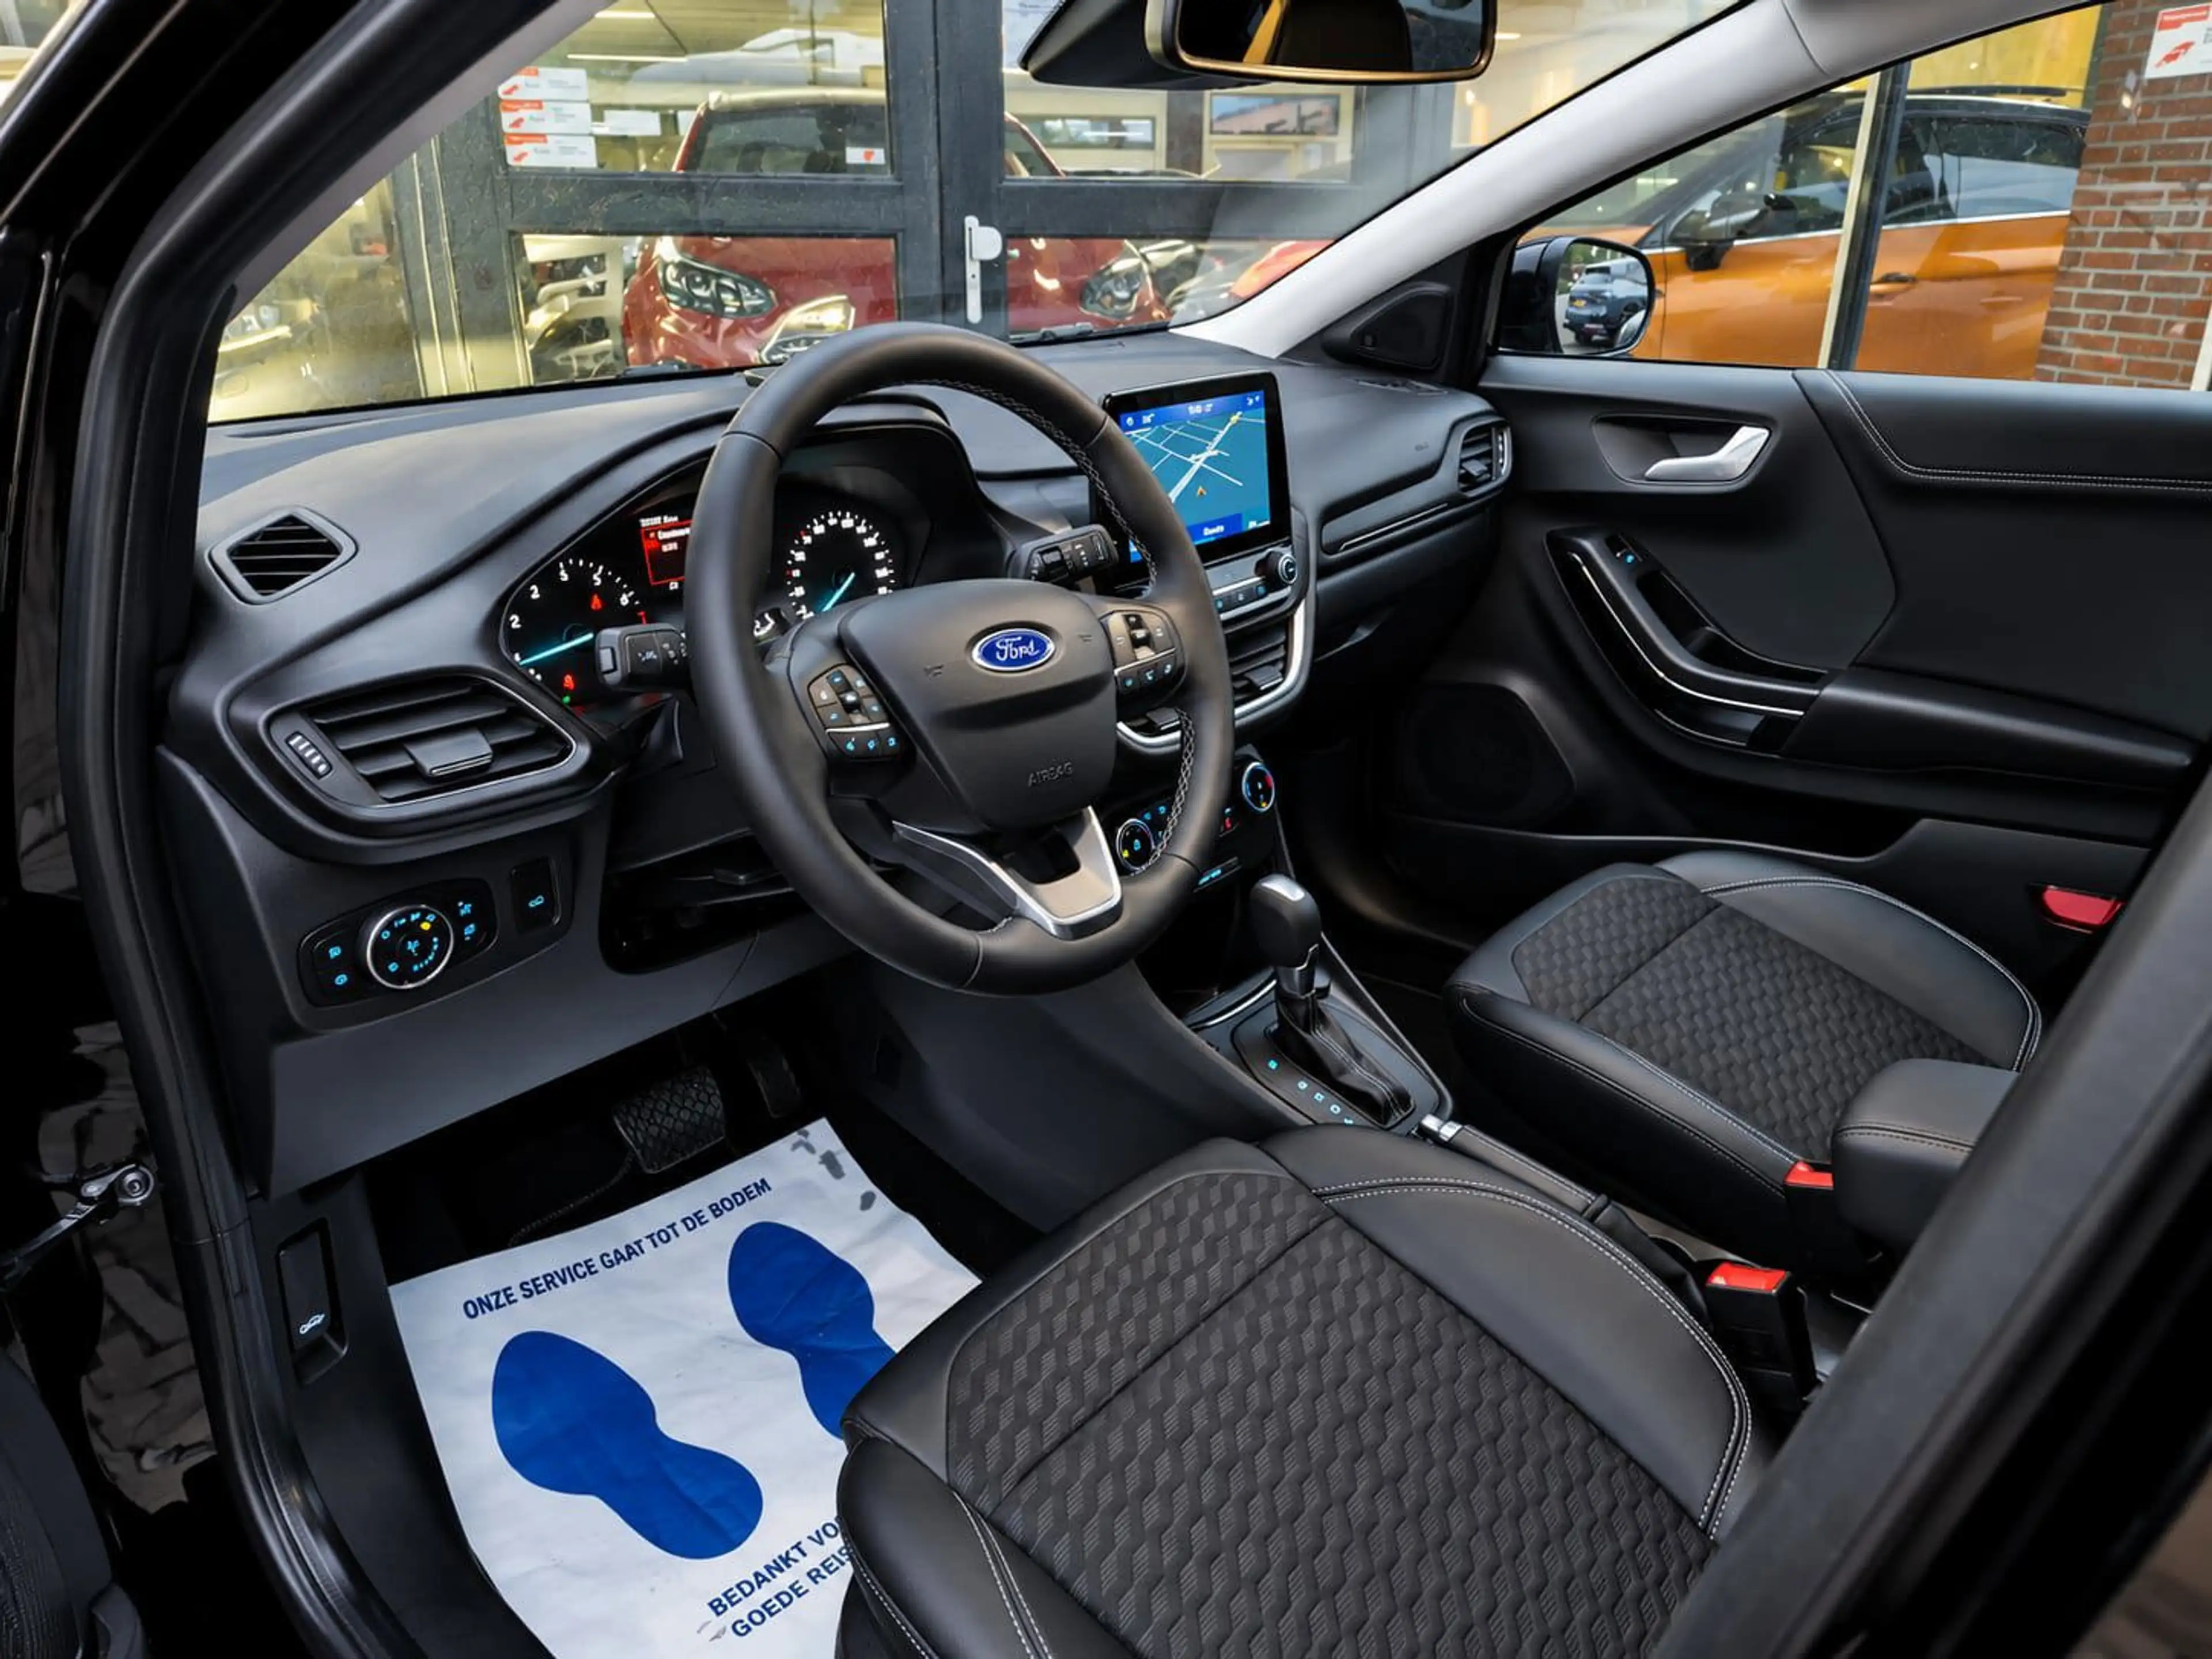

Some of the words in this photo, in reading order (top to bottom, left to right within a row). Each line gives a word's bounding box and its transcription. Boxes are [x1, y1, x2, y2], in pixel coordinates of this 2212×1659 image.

[995, 636, 1040, 661] Ford
[1027, 762, 1074, 787] AIRBAG
[463, 1286, 518, 1320] ONZE
[519, 1257, 599, 1300] SERVICE
[599, 1238, 646, 1270] GAAT
[646, 1221, 682, 1249] TOT
[681, 1209, 709, 1232] DE
[708, 1177, 772, 1218] BODEM
[707, 1541, 808, 1618] BEDANKT
[807, 1517, 841, 1547] VO
[731, 1580, 809, 1637] GOEDE
